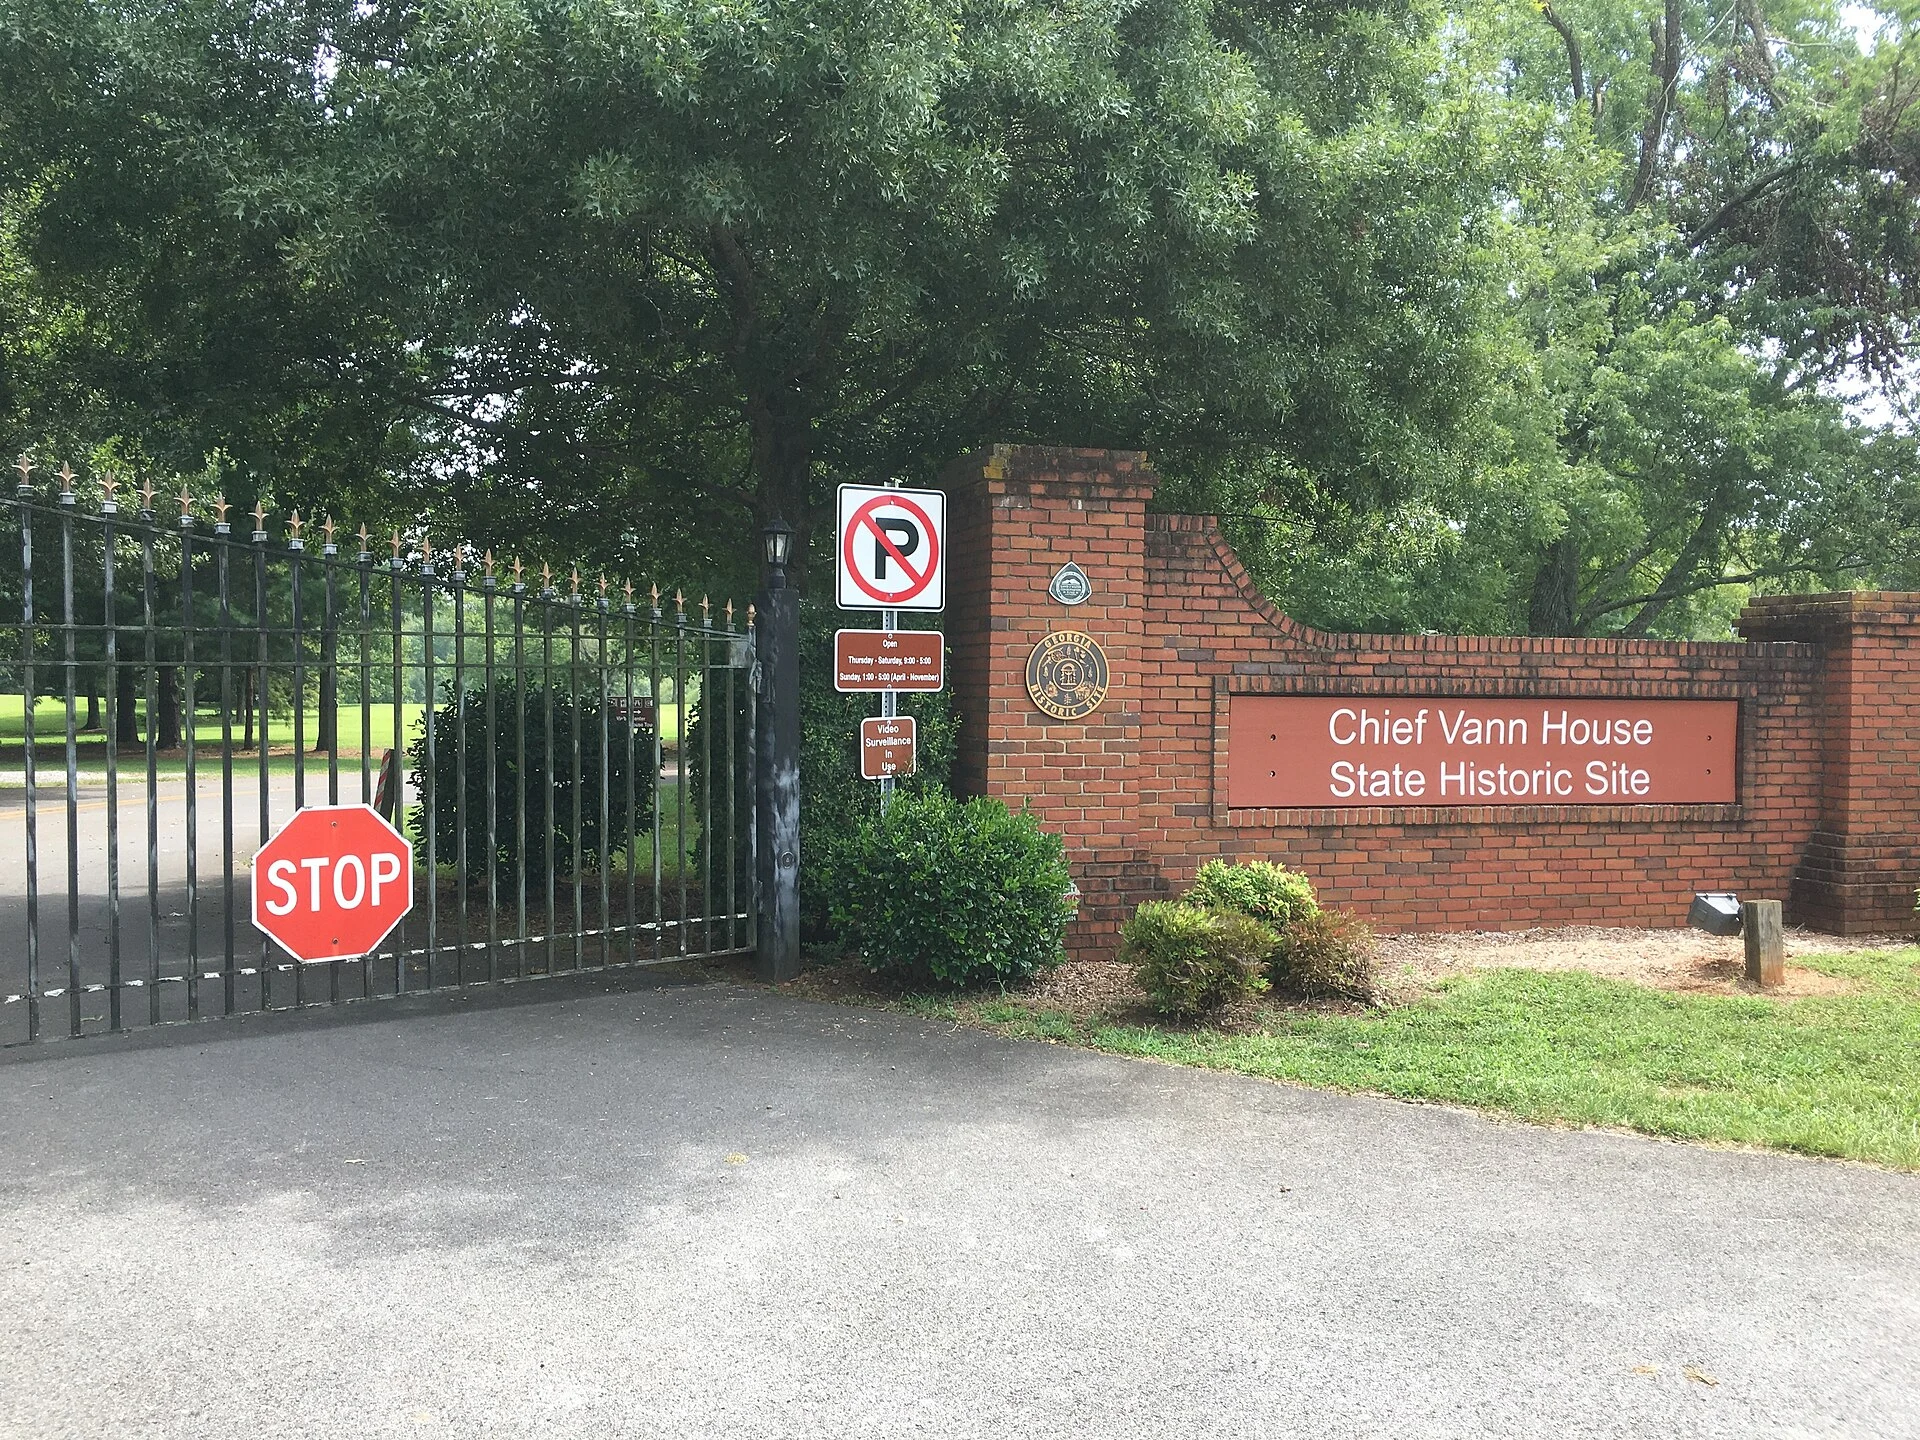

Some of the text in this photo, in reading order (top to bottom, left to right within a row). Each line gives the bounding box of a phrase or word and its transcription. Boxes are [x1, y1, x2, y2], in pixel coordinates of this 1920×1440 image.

[882, 640, 898, 649] Open
[1044, 633, 1092, 649] GEORGIA
[848, 656, 874, 666] Thursday
[878, 656, 903, 666] Saturday,
[904, 657, 916, 665] 9:00
[919, 657, 932, 665] 5:00
[839, 673, 862, 682] Sunday,
[862, 673, 874, 681] 1:00
[878, 673, 890, 681] 5:00
[890, 673, 906, 682] (April
[910, 673, 939, 682] November)
[1031, 683, 1105, 717] HISTORIC SITE
[877, 724, 899, 734] Video
[1328, 708, 1653, 745] Chief Vann House
[865, 736, 911, 748] Surveillance
[885, 749, 893, 758] In
[881, 762, 897, 771] Use
[1330, 759, 1651, 798] State Historic Site
[265, 852, 401, 916] STOP
